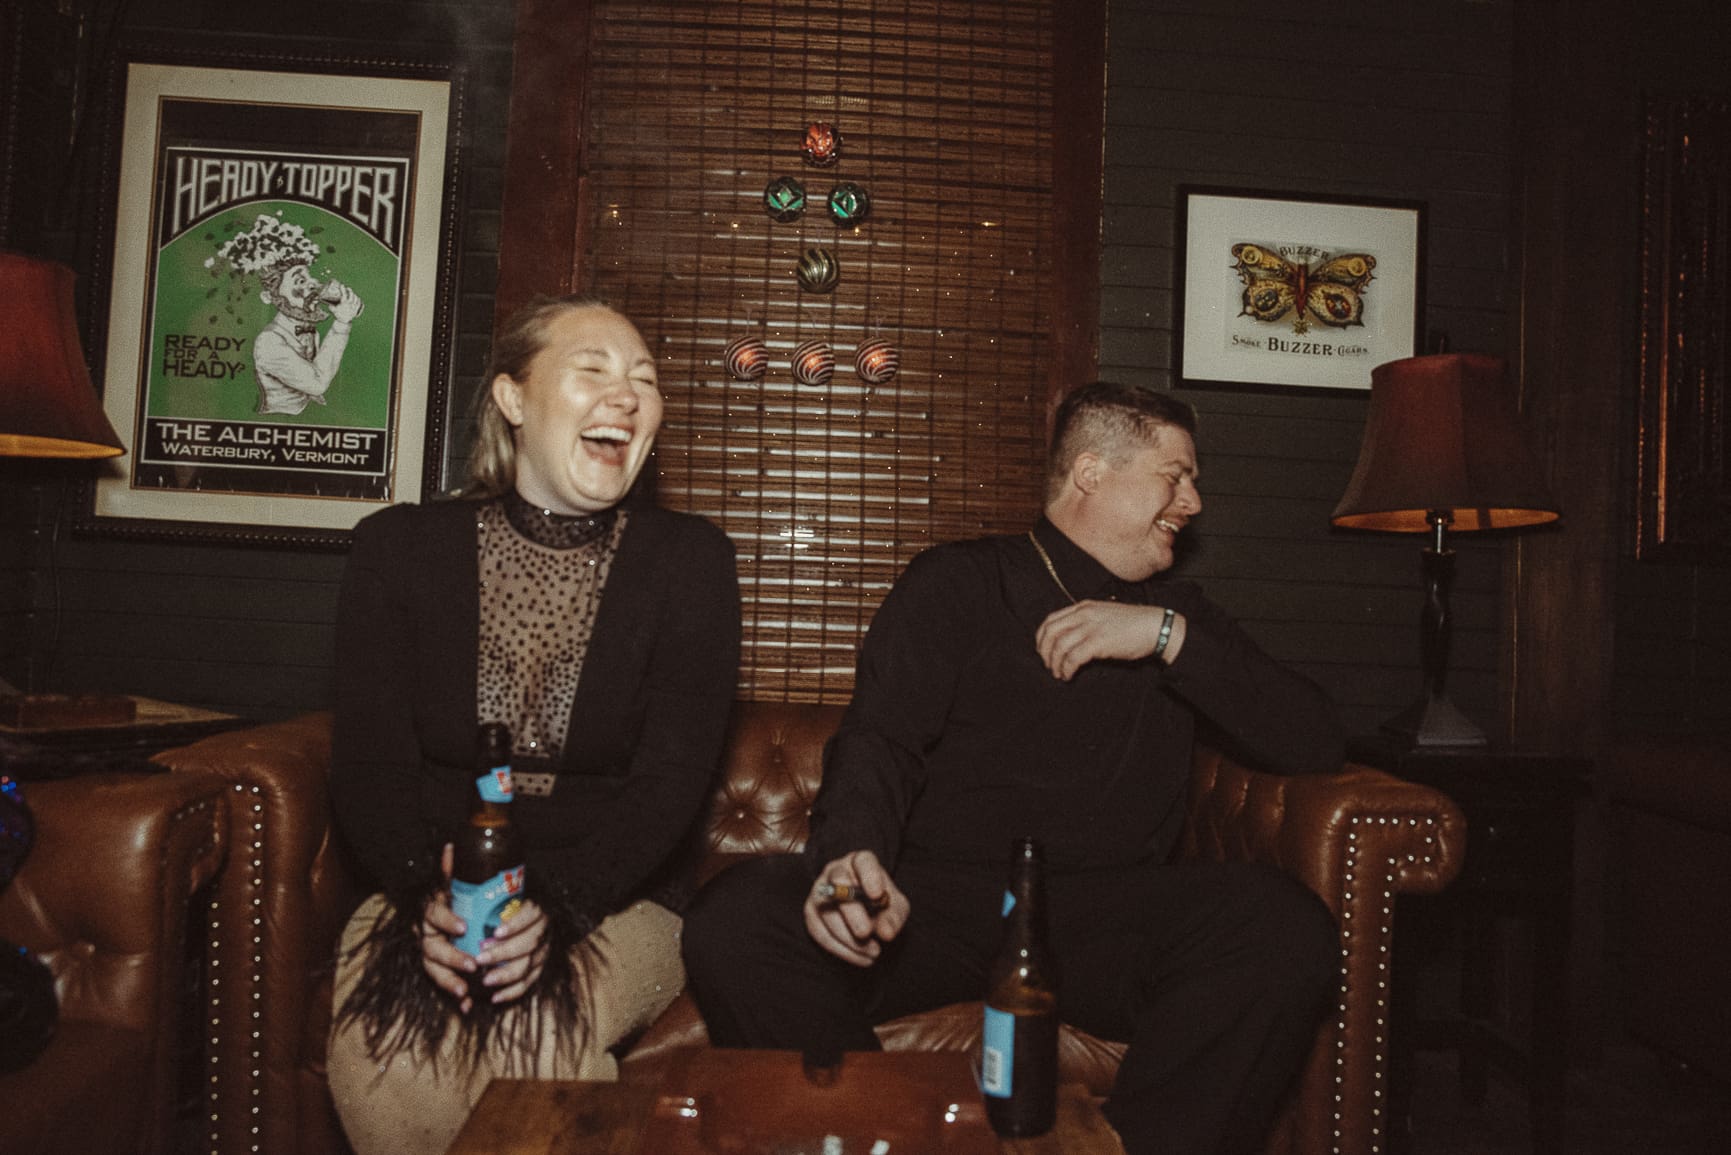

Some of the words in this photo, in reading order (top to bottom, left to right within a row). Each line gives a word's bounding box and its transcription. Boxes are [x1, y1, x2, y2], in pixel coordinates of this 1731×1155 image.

[172, 156, 278, 238] HEADY
[281, 162, 398, 248] TOPPER
[1279, 246, 1330, 261] BUZZER
[164, 334, 247, 352] READY
[1268, 337, 1333, 356] BUZZER
[163, 348, 199, 360] FOR
[208, 350, 220, 360] A
[156, 422, 212, 442] THE
[218, 425, 379, 451] ALCHEMIST
[282, 447, 370, 466] VERMONT
